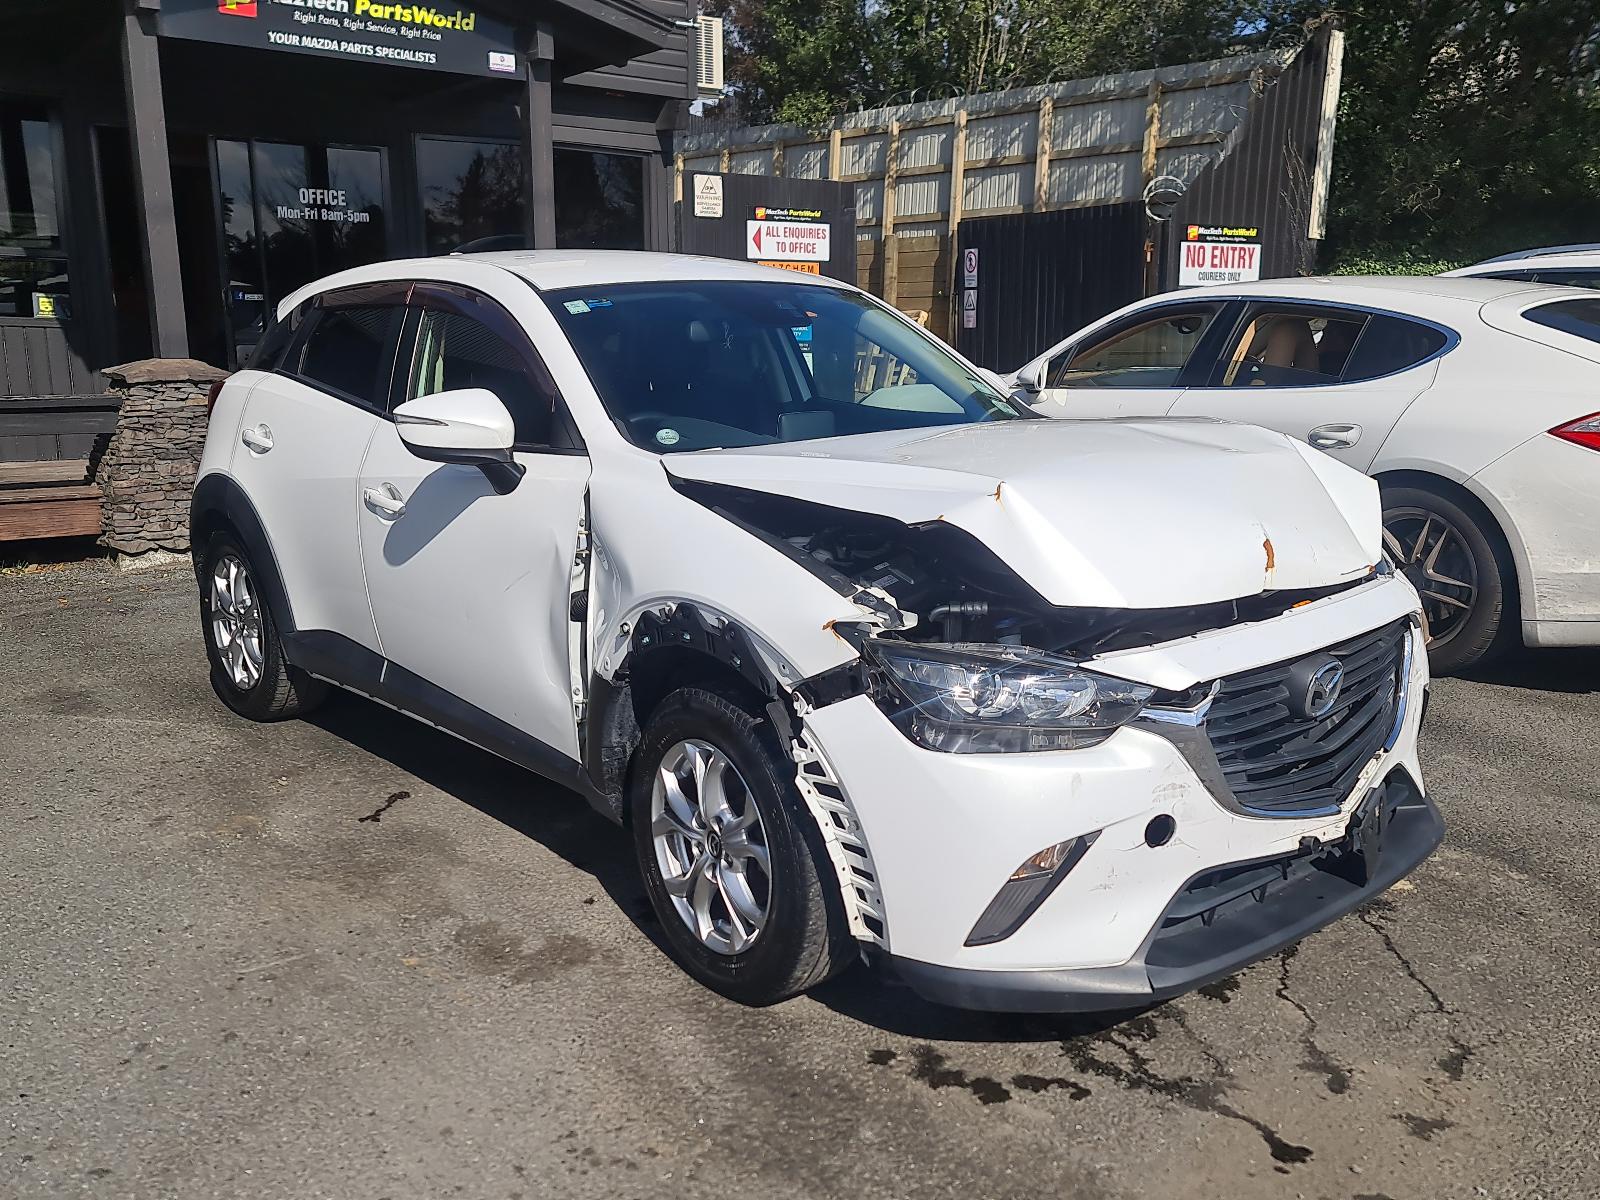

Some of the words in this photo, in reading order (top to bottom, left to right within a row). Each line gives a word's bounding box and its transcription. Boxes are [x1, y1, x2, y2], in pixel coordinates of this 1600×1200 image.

[267, 0, 349, 13] azTech
[354, 0, 476, 31] PartsWorld
[293, 10, 317, 25] Right
[318, 14, 341, 28] Parts,
[343, 17, 365, 31] Right
[366, 21, 398, 36] Service,
[400, 25, 421, 39] Right
[422, 29, 442, 41] Price
[267, 31, 300, 46] YOUR
[301, 36, 339, 50] MAZDA
[340, 41, 374, 55] PARTS
[376, 46, 437, 63] SPECIALISTS
[299, 187, 346, 206] OFFICE
[277, 206, 318, 221] Mon-Fri
[321, 208, 370, 223] 8am-5pm
[789, 209, 821, 217] PartsWorld
[765, 225, 781, 238] ALL
[783, 226, 827, 240] ENQUIRIES
[1222, 227, 1258, 236] PartsWorld
[776, 241, 786, 253] TO
[789, 242, 817, 254] OFFICE
[1185, 244, 1206, 268] NO
[1210, 245, 1256, 270] ENTRY
[1198, 271, 1227, 281] COURIERS
[1227, 271, 1242, 281] ONLY
